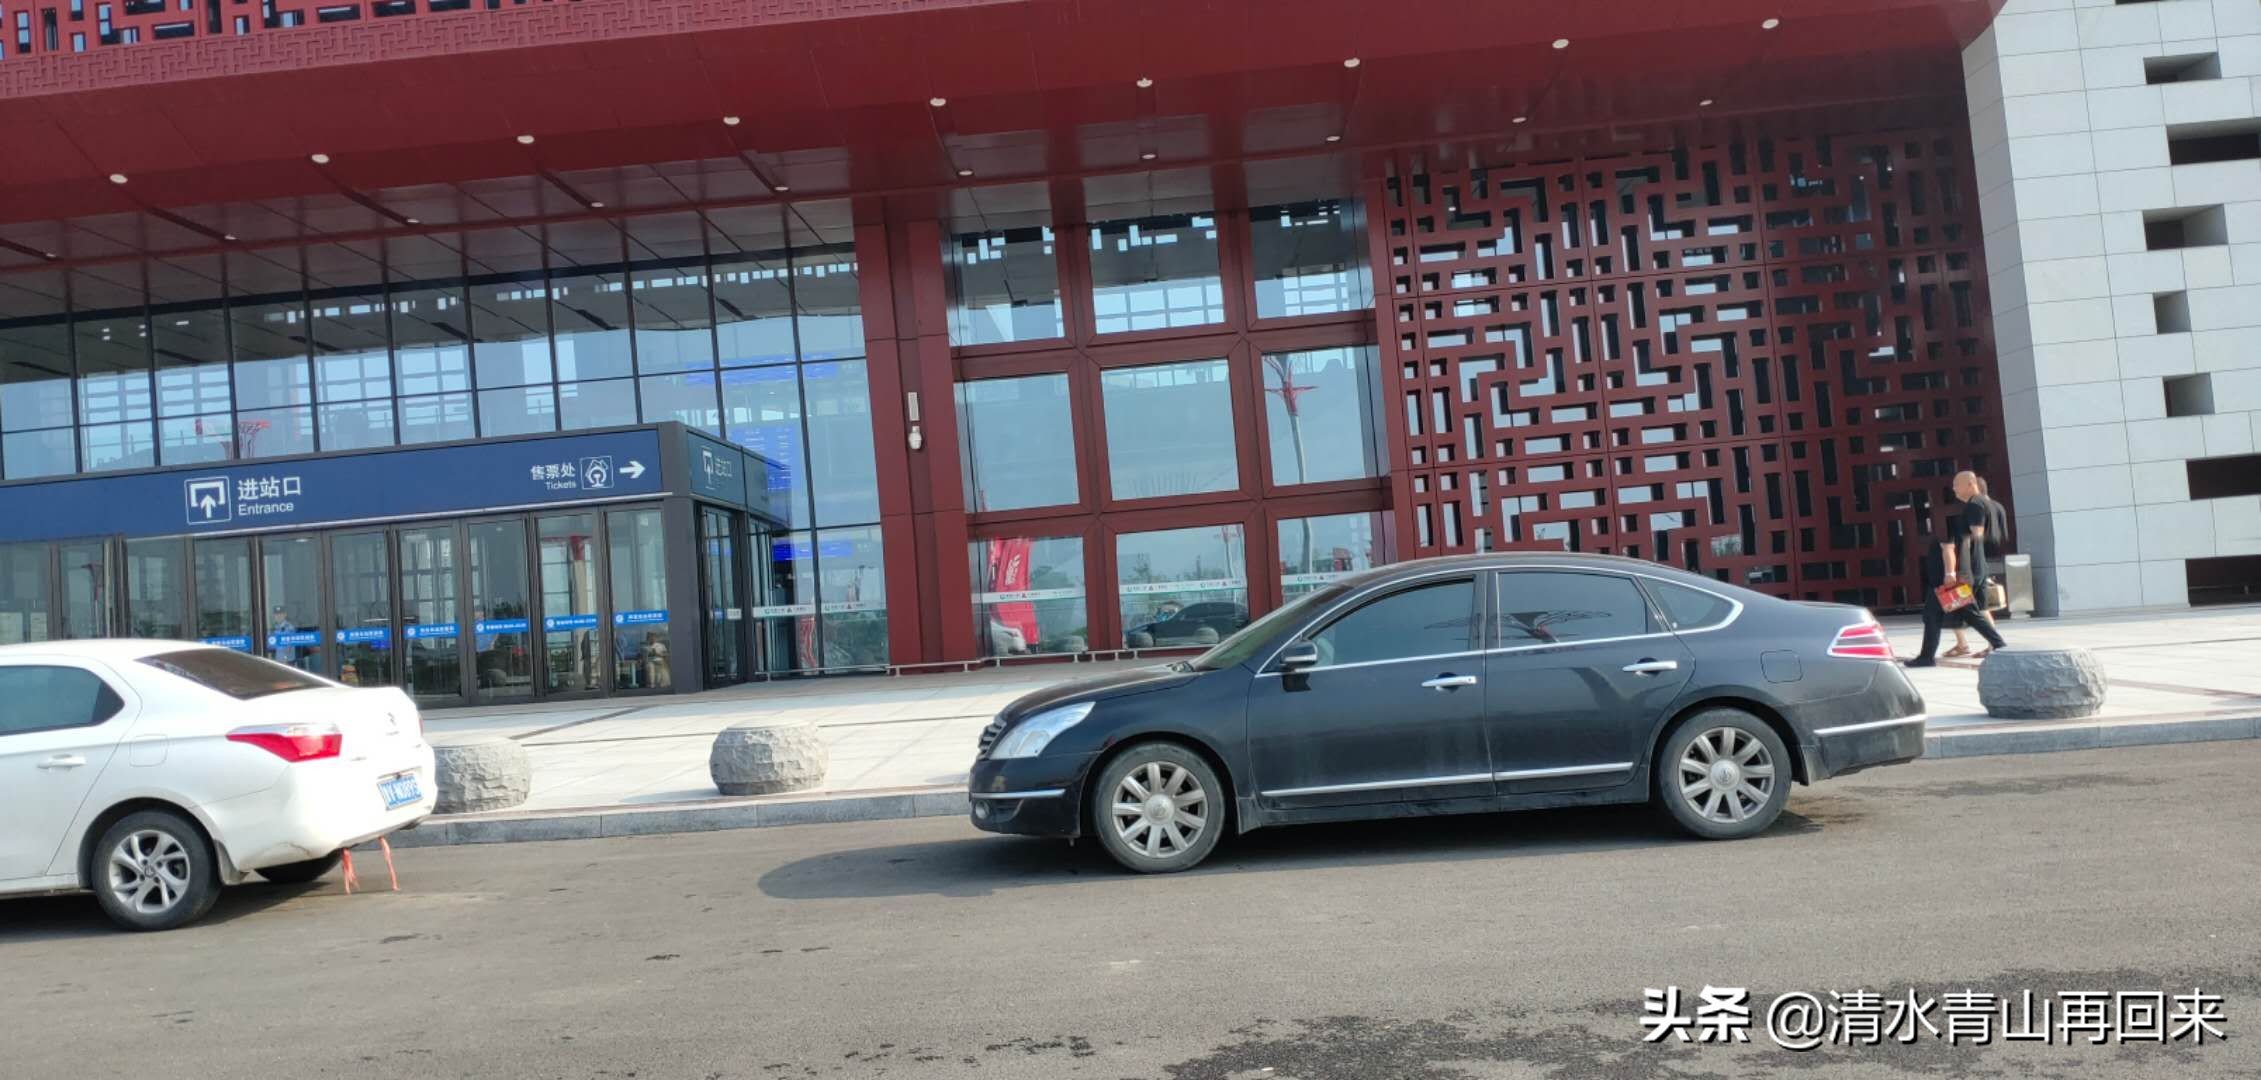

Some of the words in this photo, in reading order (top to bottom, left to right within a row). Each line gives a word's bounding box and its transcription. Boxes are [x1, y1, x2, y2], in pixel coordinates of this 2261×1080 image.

[530, 462, 576, 480] 售票处
[237, 475, 302, 501] 进站口
[544, 479, 577, 490] Tickets
[238, 501, 295, 516] Entrance
